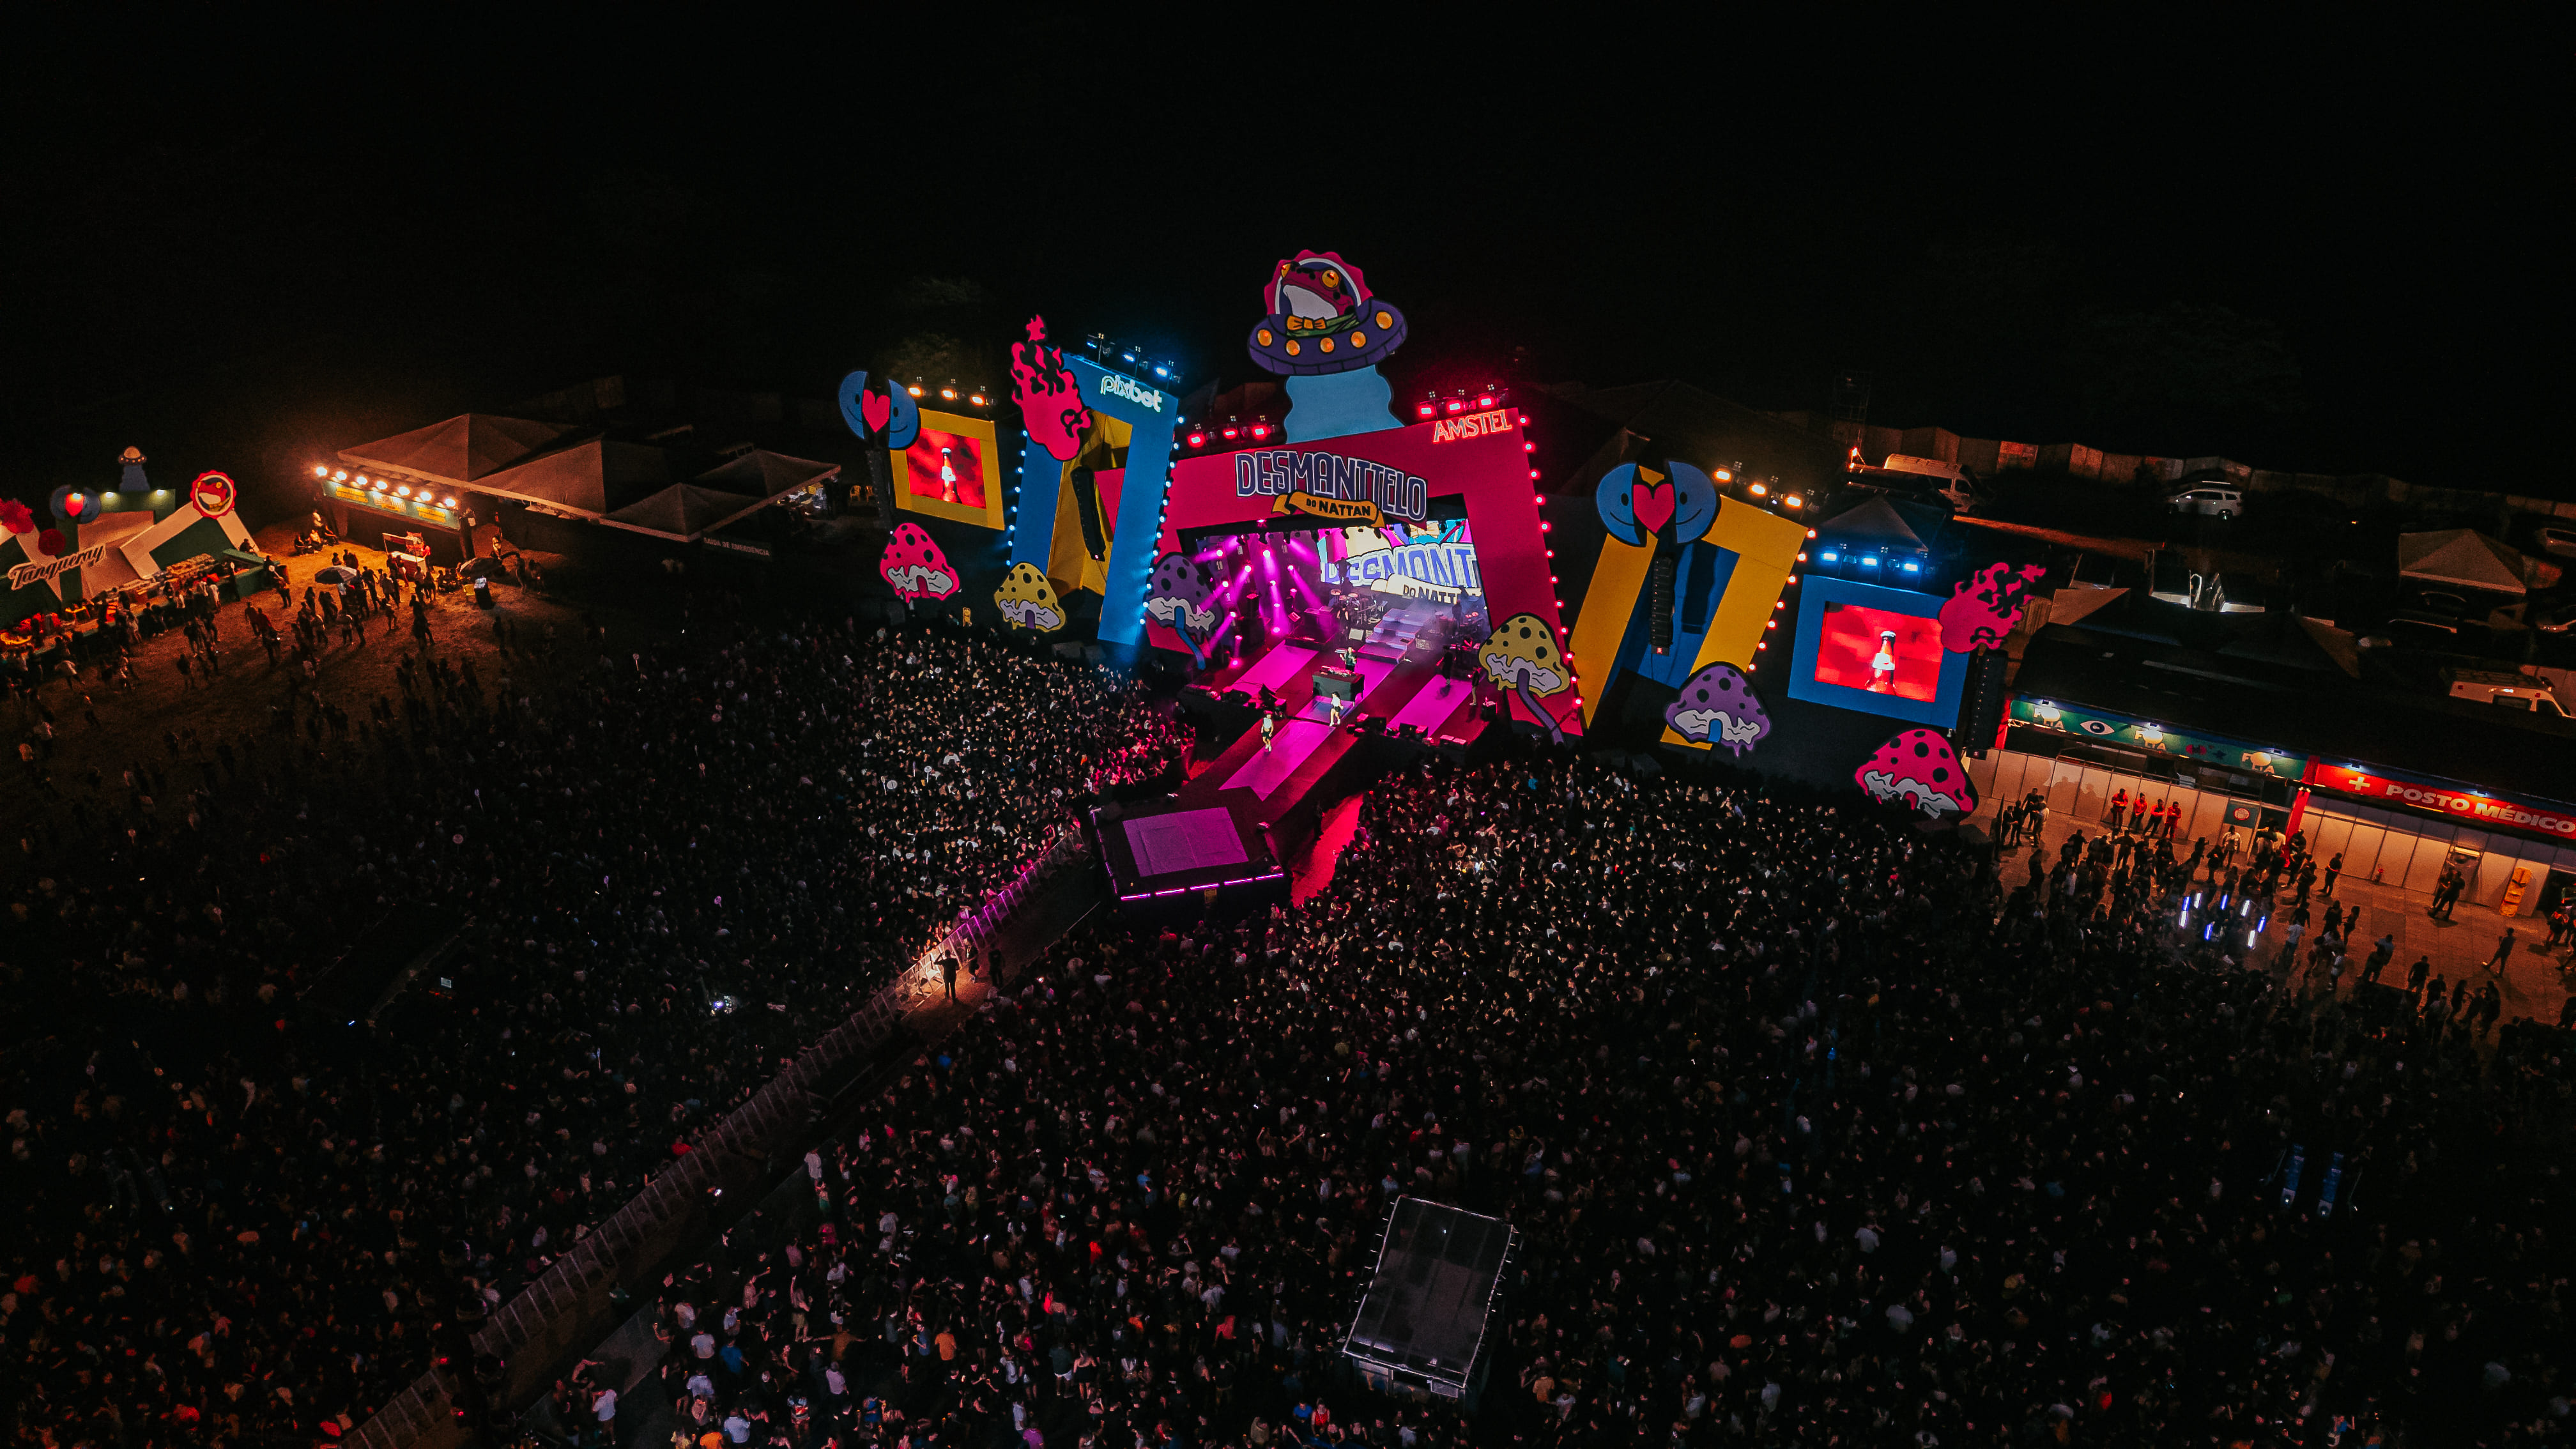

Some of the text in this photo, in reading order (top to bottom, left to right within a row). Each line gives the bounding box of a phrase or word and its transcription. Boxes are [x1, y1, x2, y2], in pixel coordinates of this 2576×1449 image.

[1100, 374, 1162, 413] pixbet
[1433, 410, 1512, 443] AMSTEL
[1235, 451, 1427, 521] DESMANTTELO
[1306, 498, 1371, 516] DO NATTAN
[8, 544, 106, 590] Tanqueray
[2386, 784, 2575, 832] POSTO MÉDICO
